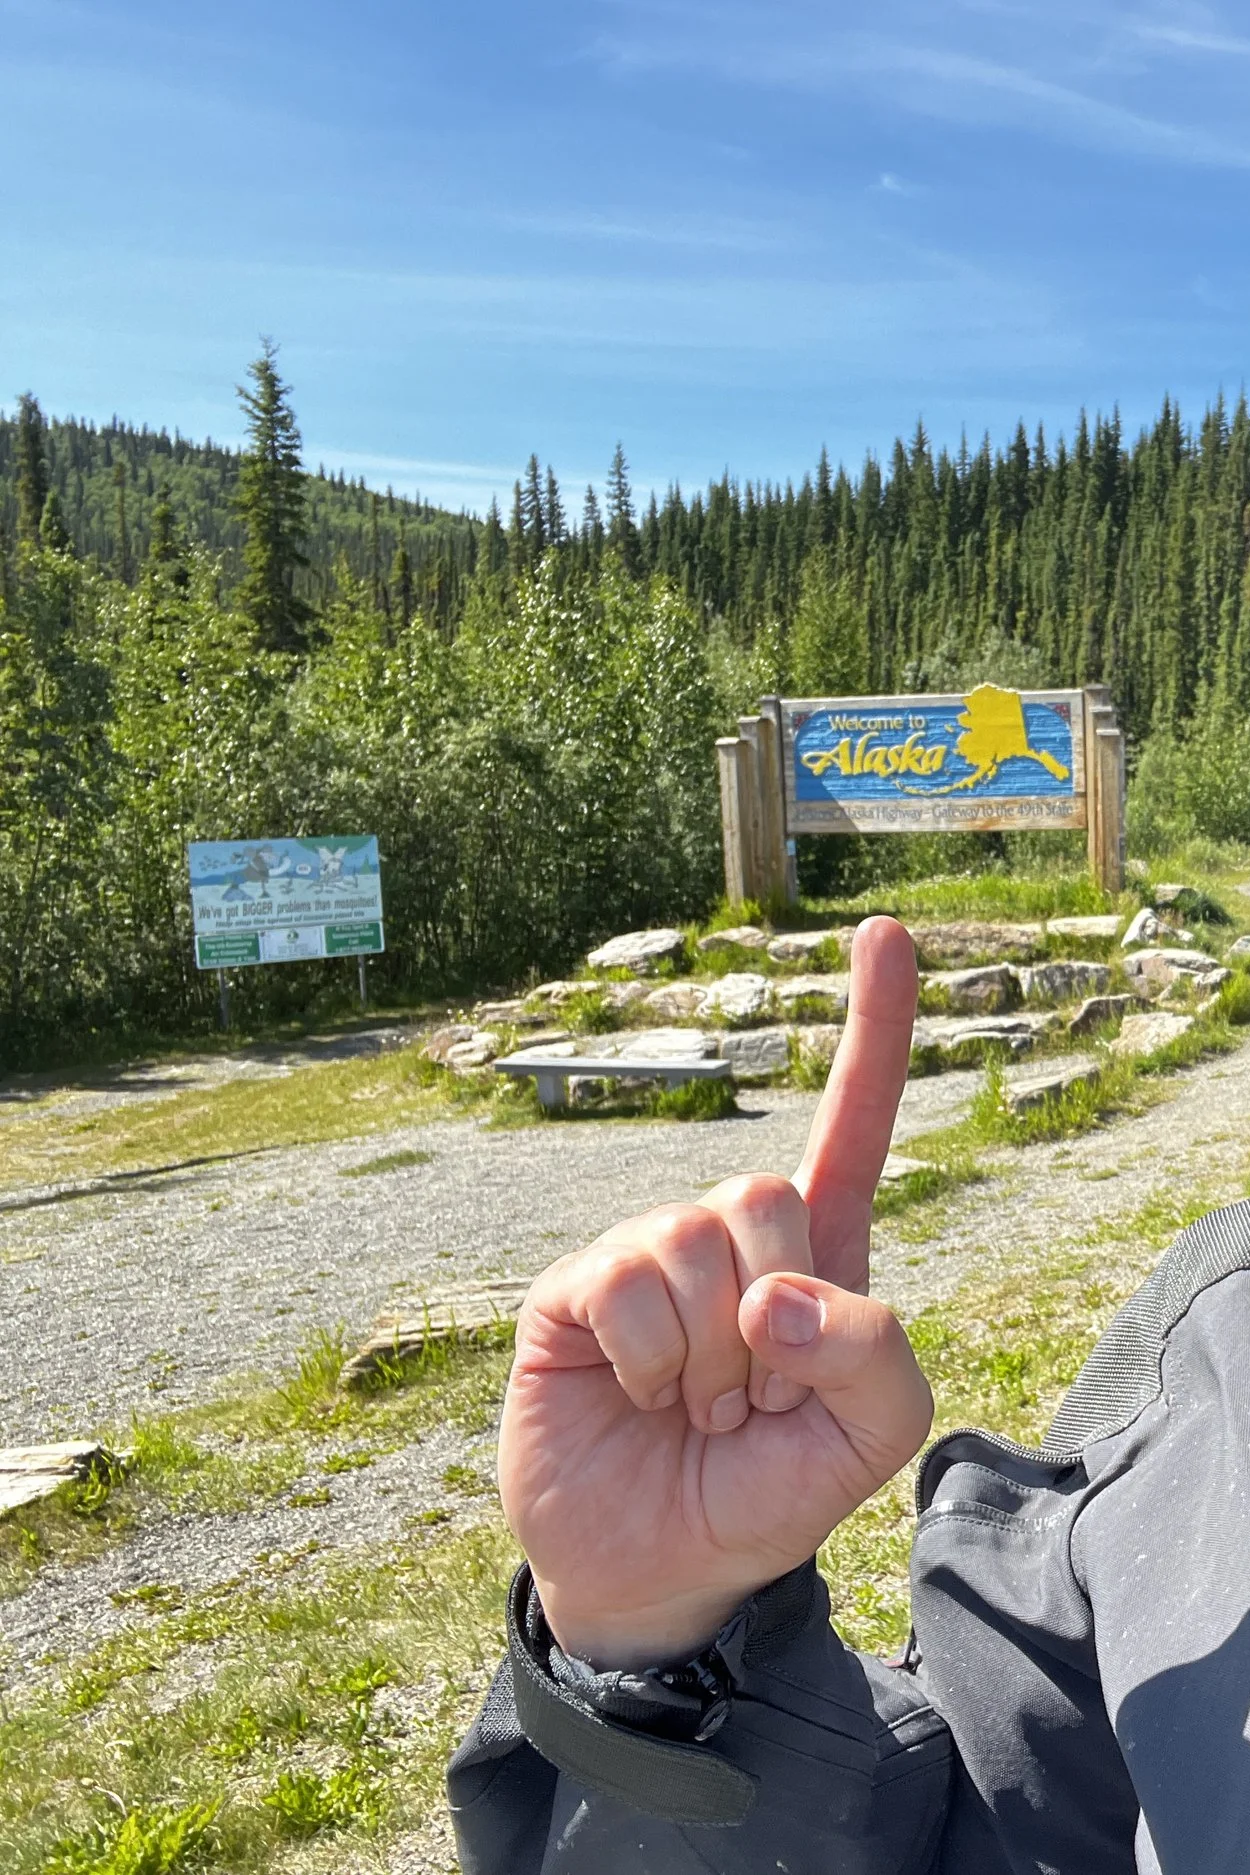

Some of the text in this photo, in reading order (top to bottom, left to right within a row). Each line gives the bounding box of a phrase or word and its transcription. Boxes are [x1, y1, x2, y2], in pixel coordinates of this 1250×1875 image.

[828, 713, 926, 731] Welcome to
[801, 731, 948, 777] Alaska
[876, 806, 922, 822] Highway
[931, 804, 981, 821] Gateway
[982, 803, 994, 817] to
[995, 803, 1014, 817] the
[1017, 802, 1044, 817] 49th
[1045, 801, 1073, 817] State
[198, 905, 222, 920] We've
[225, 904, 239, 921] got
[242, 901, 273, 917] BIGGER
[277, 899, 311, 918] problems
[314, 898, 330, 911] than
